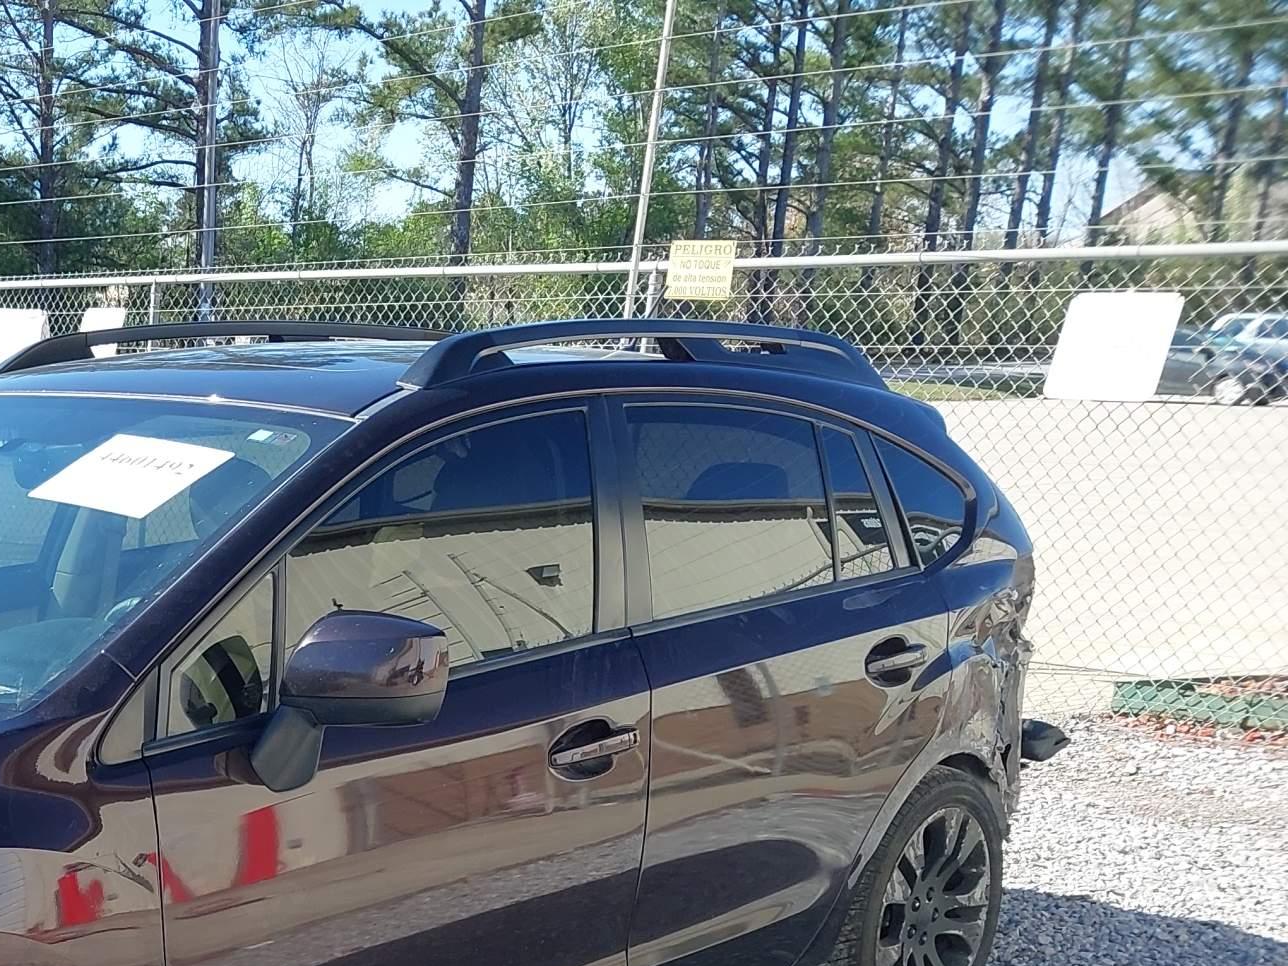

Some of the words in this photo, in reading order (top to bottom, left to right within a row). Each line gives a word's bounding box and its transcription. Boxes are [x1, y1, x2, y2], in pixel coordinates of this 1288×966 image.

[674, 244, 733, 256] PELIGRO
[679, 259, 692, 270] NO
[694, 259, 721, 270] TOQUE
[689, 286, 727, 297] VOLTIOS
